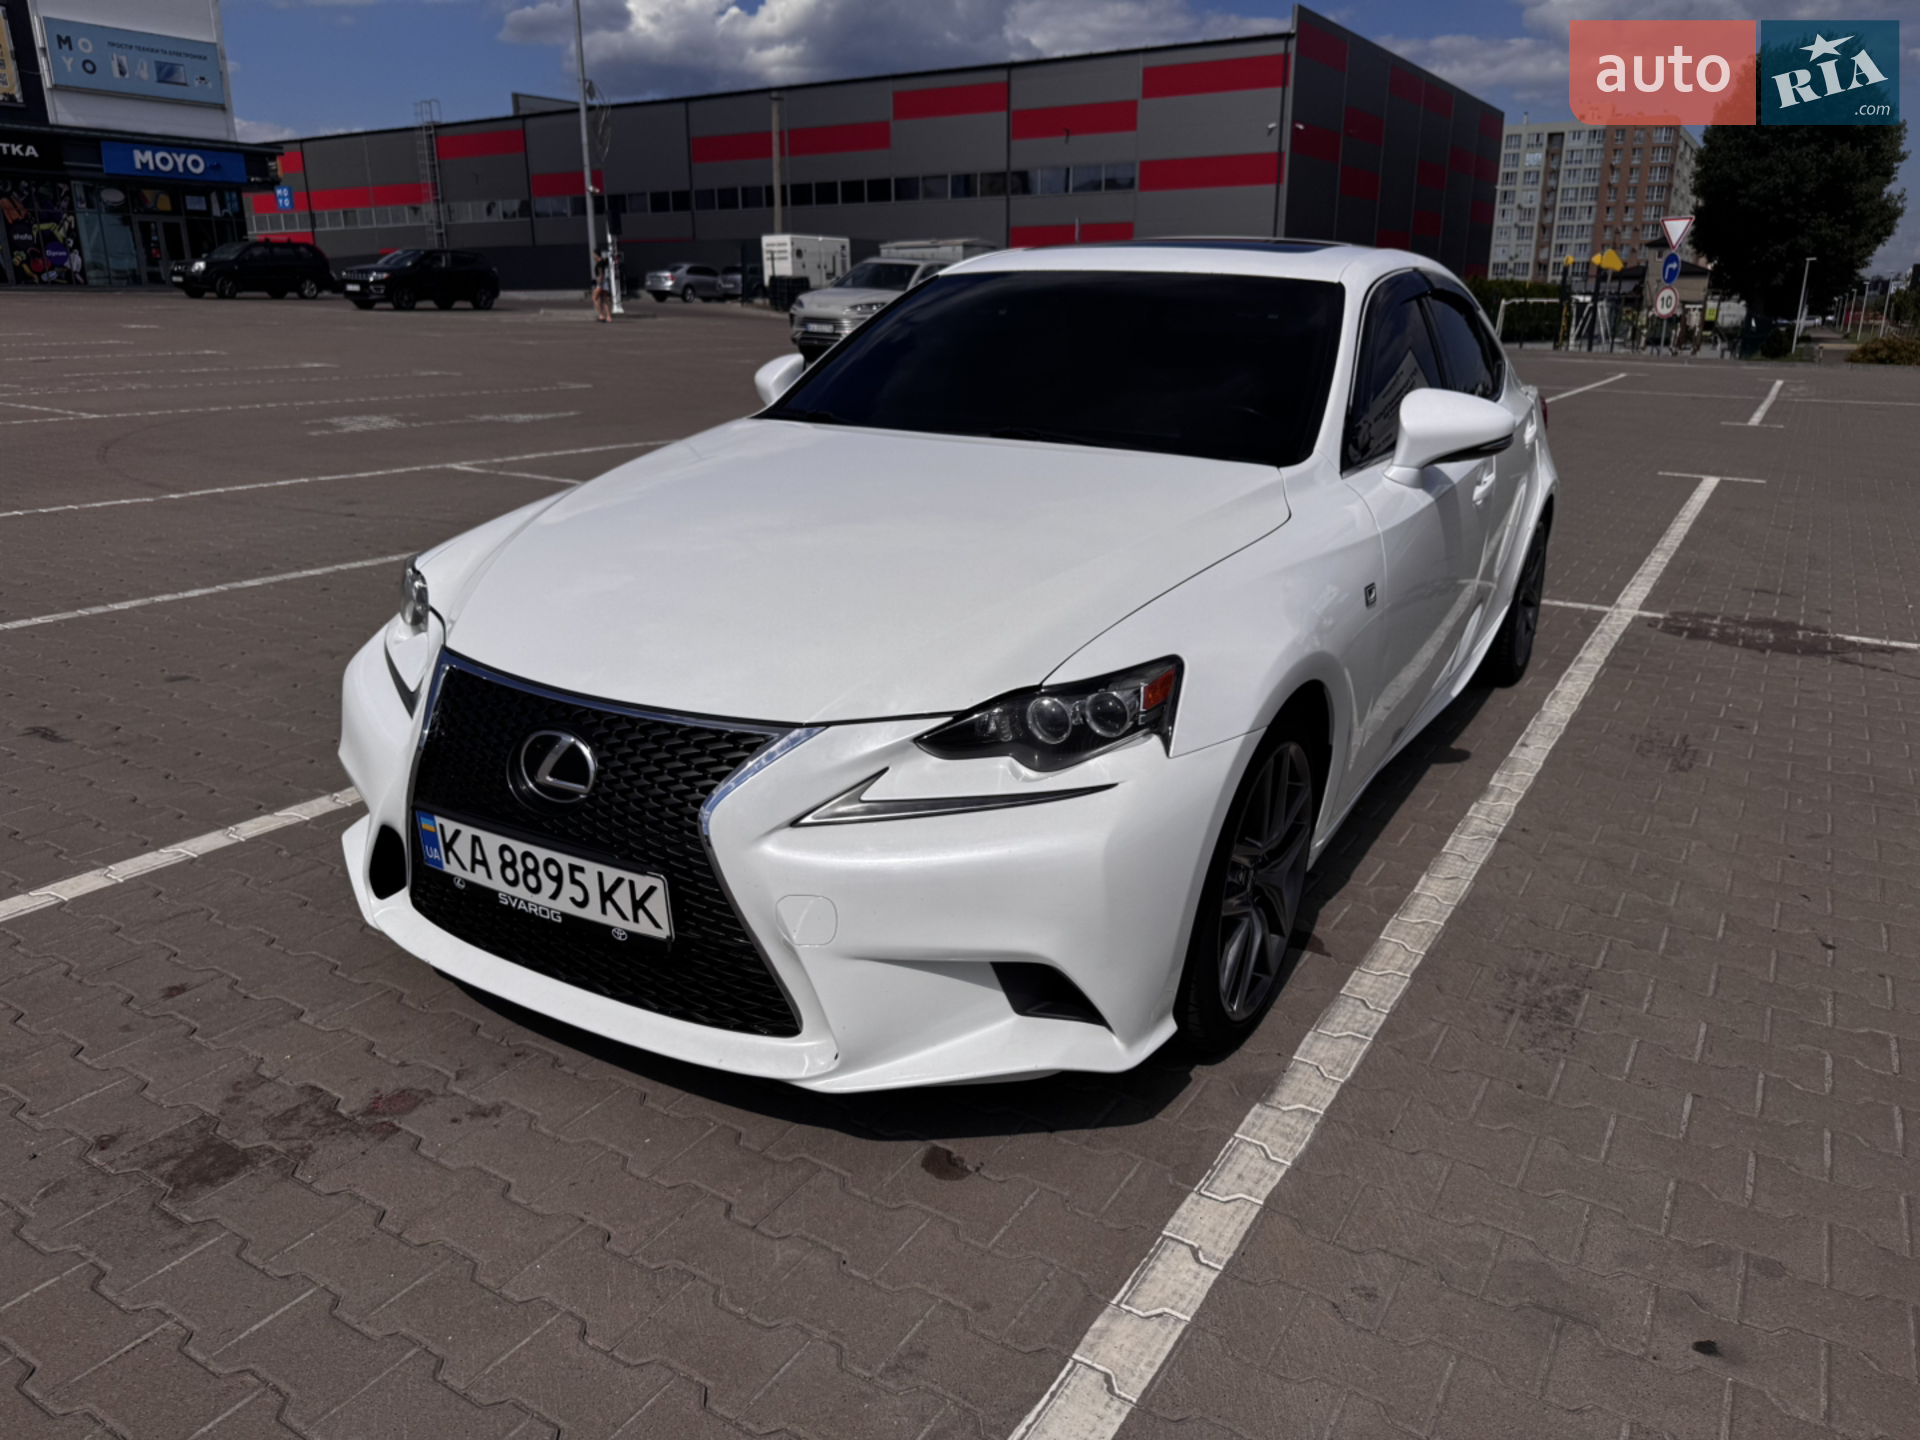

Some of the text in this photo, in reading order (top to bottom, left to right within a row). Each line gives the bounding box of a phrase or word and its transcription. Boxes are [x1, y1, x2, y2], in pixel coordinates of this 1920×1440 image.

[133, 149, 205, 174] MOYO
[1661, 295, 1673, 309] 10
[425, 845, 441, 862] UA
[439, 823, 663, 930] KA 8895 KK
[498, 892, 562, 923] SVAROG
